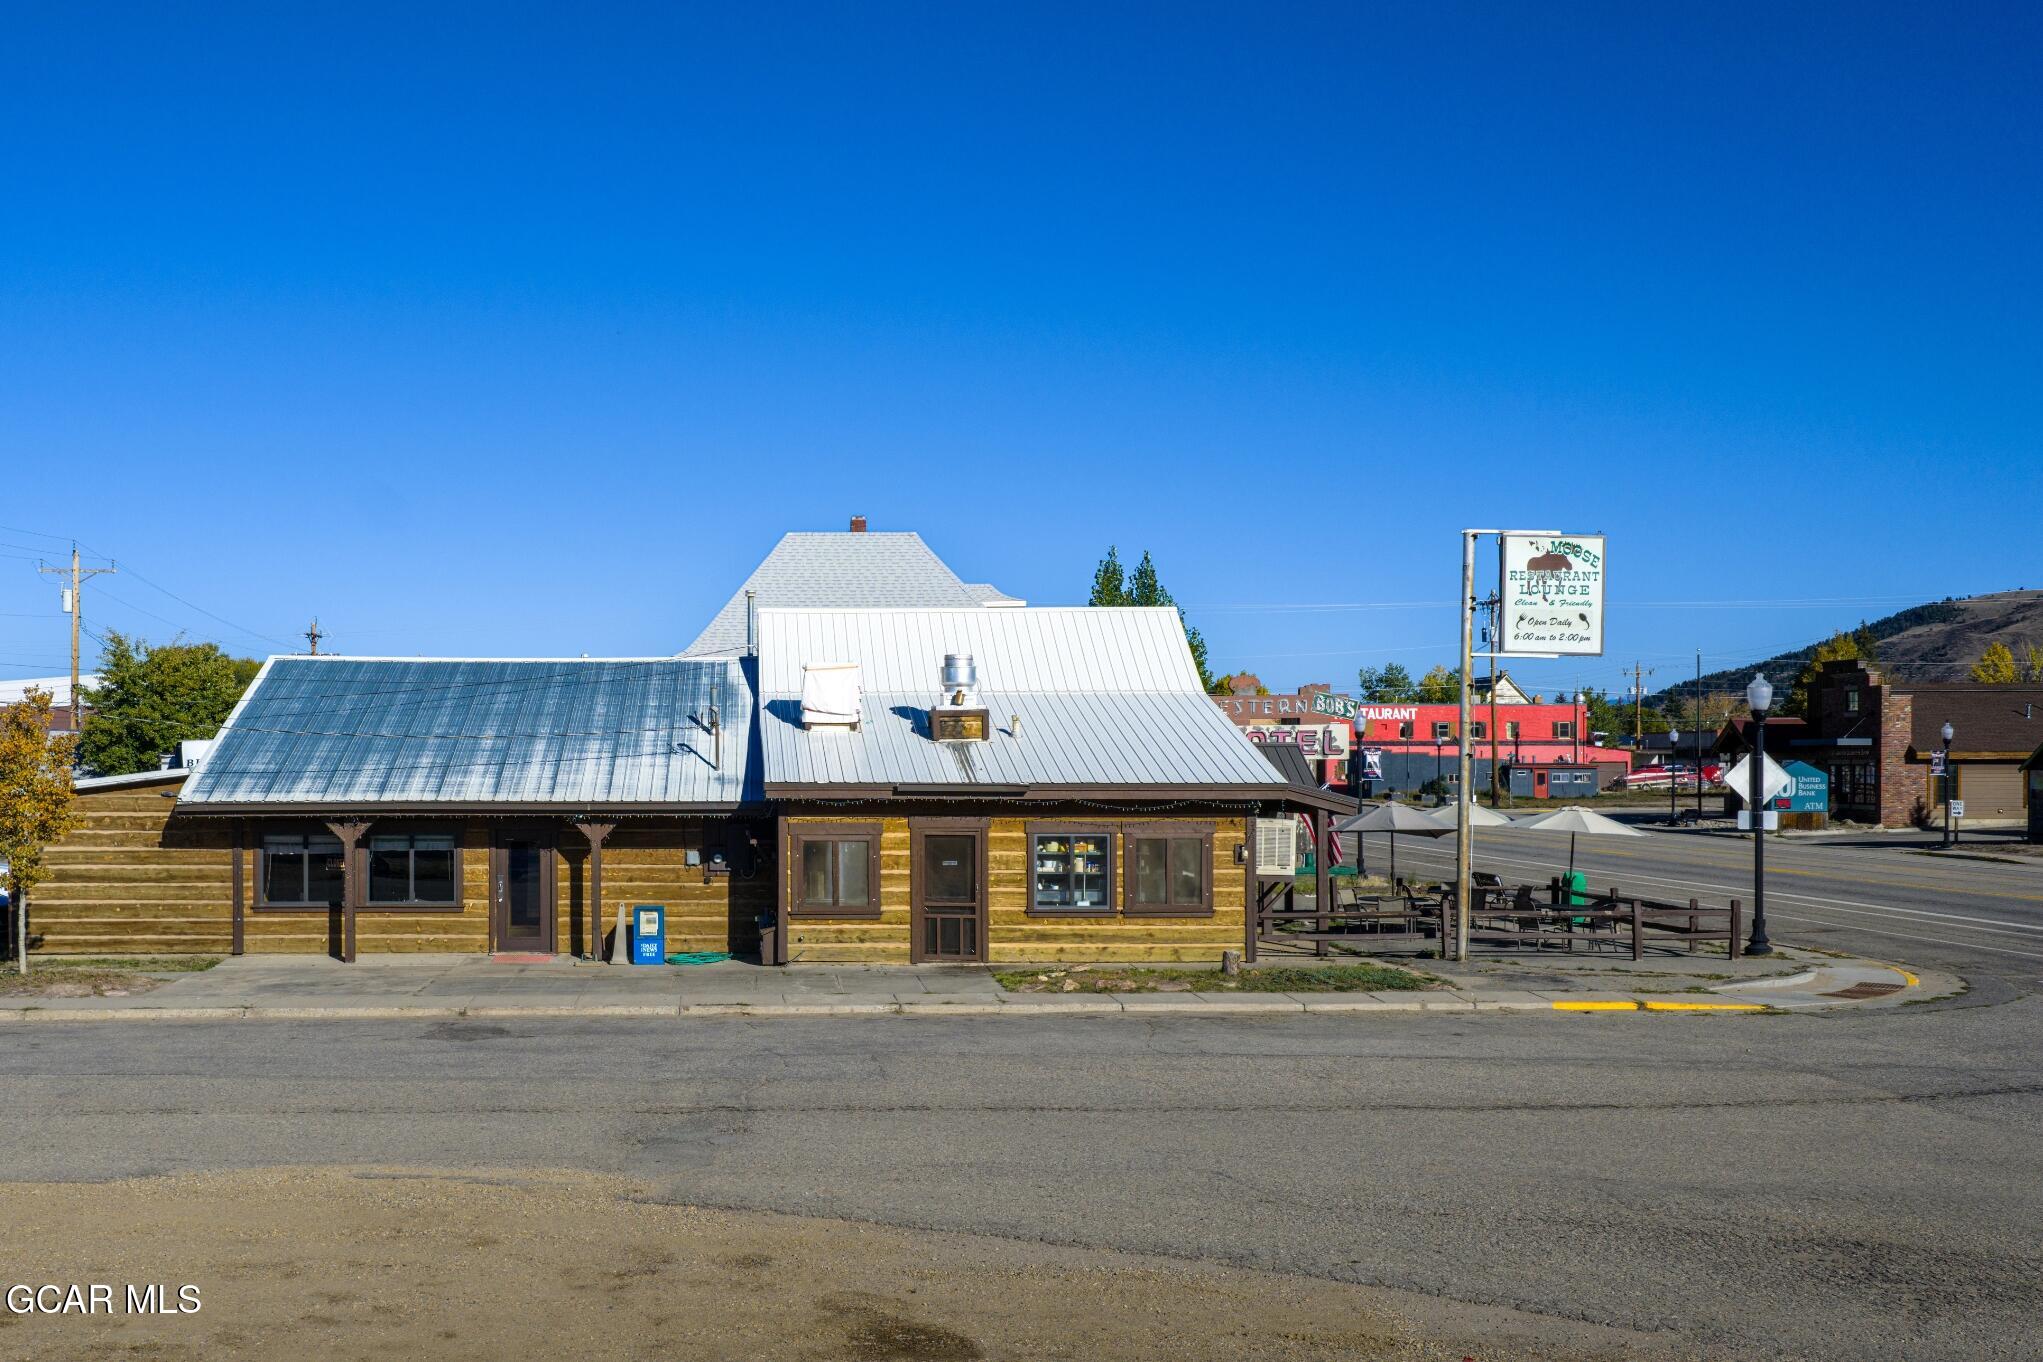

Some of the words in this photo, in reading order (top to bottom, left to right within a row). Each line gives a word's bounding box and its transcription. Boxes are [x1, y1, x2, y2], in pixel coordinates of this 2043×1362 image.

[1550, 541, 1600, 568] MOOSE
[1509, 570, 1600, 581] RESTAURANT
[1519, 584, 1590, 595] LOUNGE
[1514, 598, 1538, 606] Clean
[1558, 599, 1593, 608] Friendly
[1527, 616, 1548, 627] Open
[1549, 617, 1573, 628] Daily
[1513, 632, 1534, 641] 6:00
[1558, 633, 1579, 641] 2:00
[1578, 635, 1591, 643] pm
[1315, 695, 1356, 718] BOB'S
[1803, 802, 1824, 810] ATM
